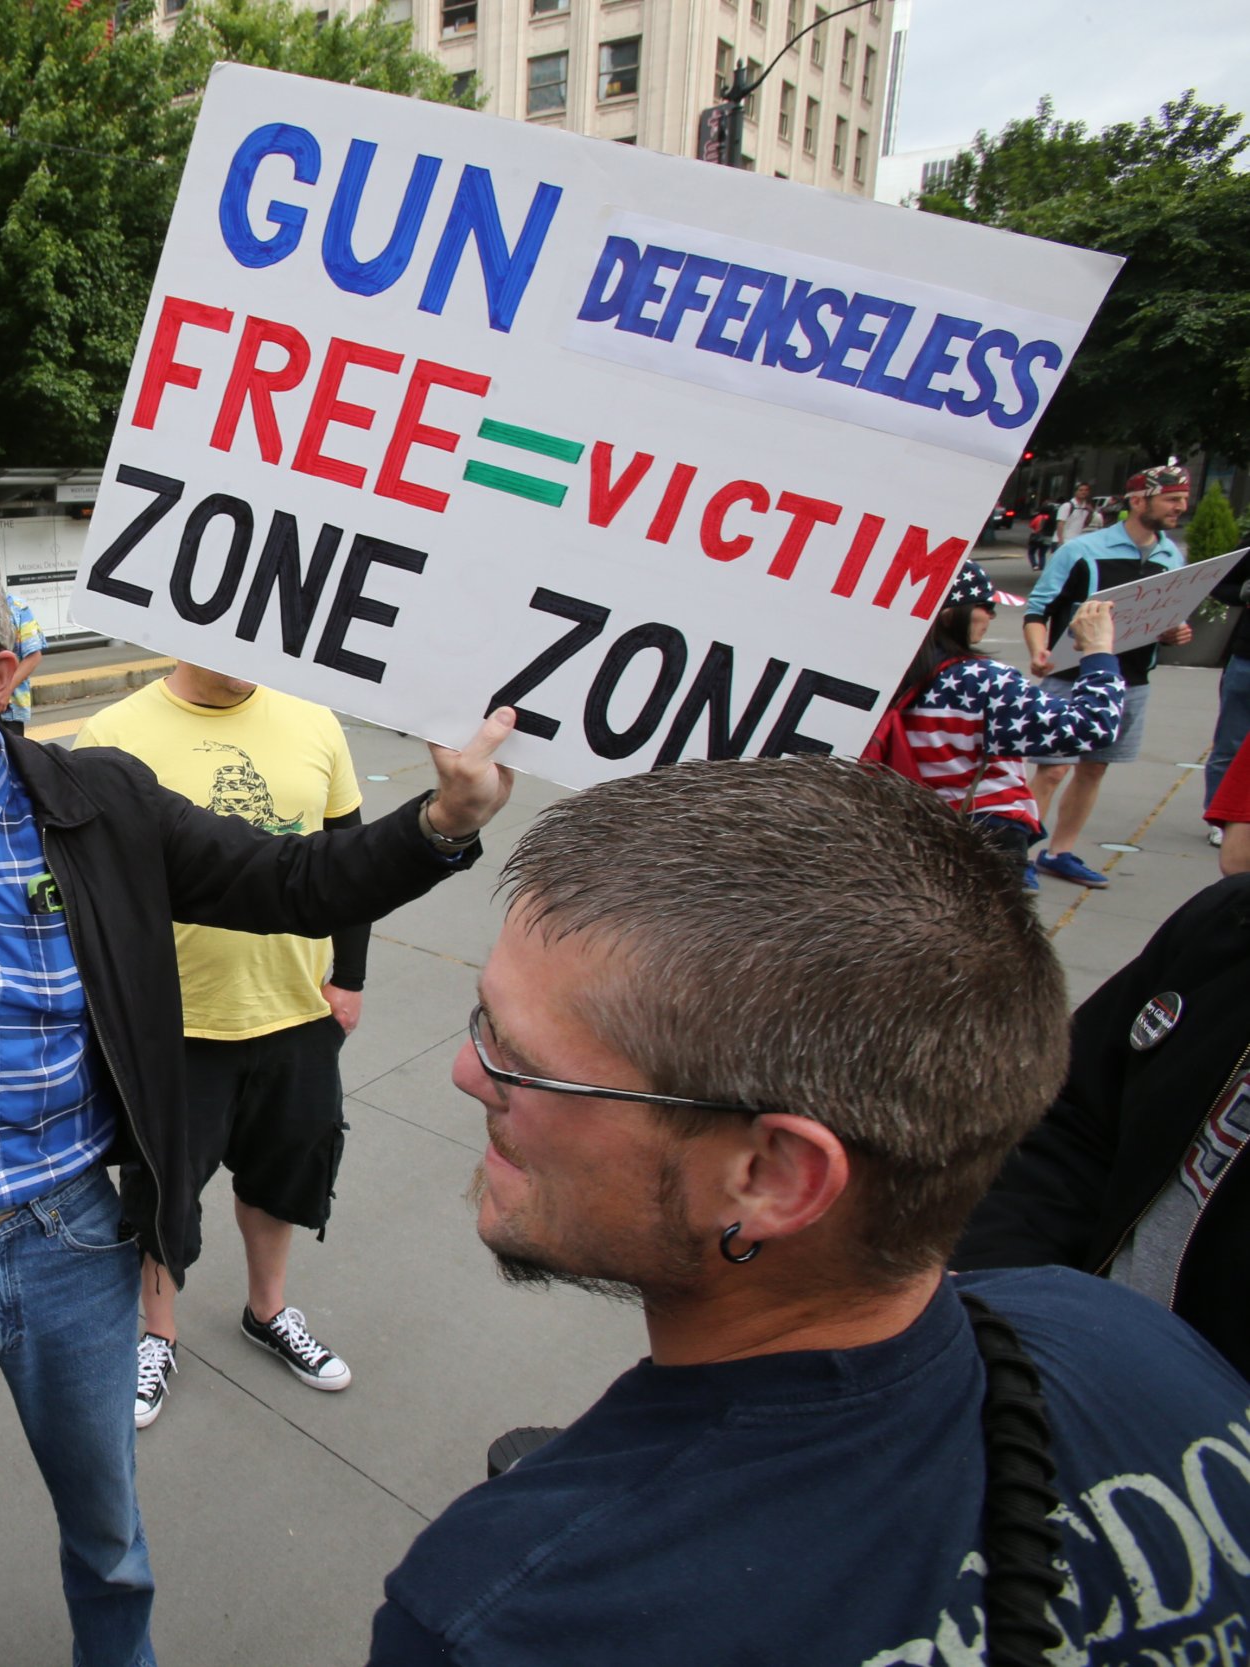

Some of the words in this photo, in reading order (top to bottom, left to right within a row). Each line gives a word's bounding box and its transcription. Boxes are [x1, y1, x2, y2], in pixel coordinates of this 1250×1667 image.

[219, 122, 563, 334] GUN
[578, 235, 1063, 430] DEFENSELESS
[132, 296, 491, 512] FREE
[588, 440, 969, 621] VICTIM
[86, 463, 429, 684] ZONE
[484, 587, 880, 773] ZONE
